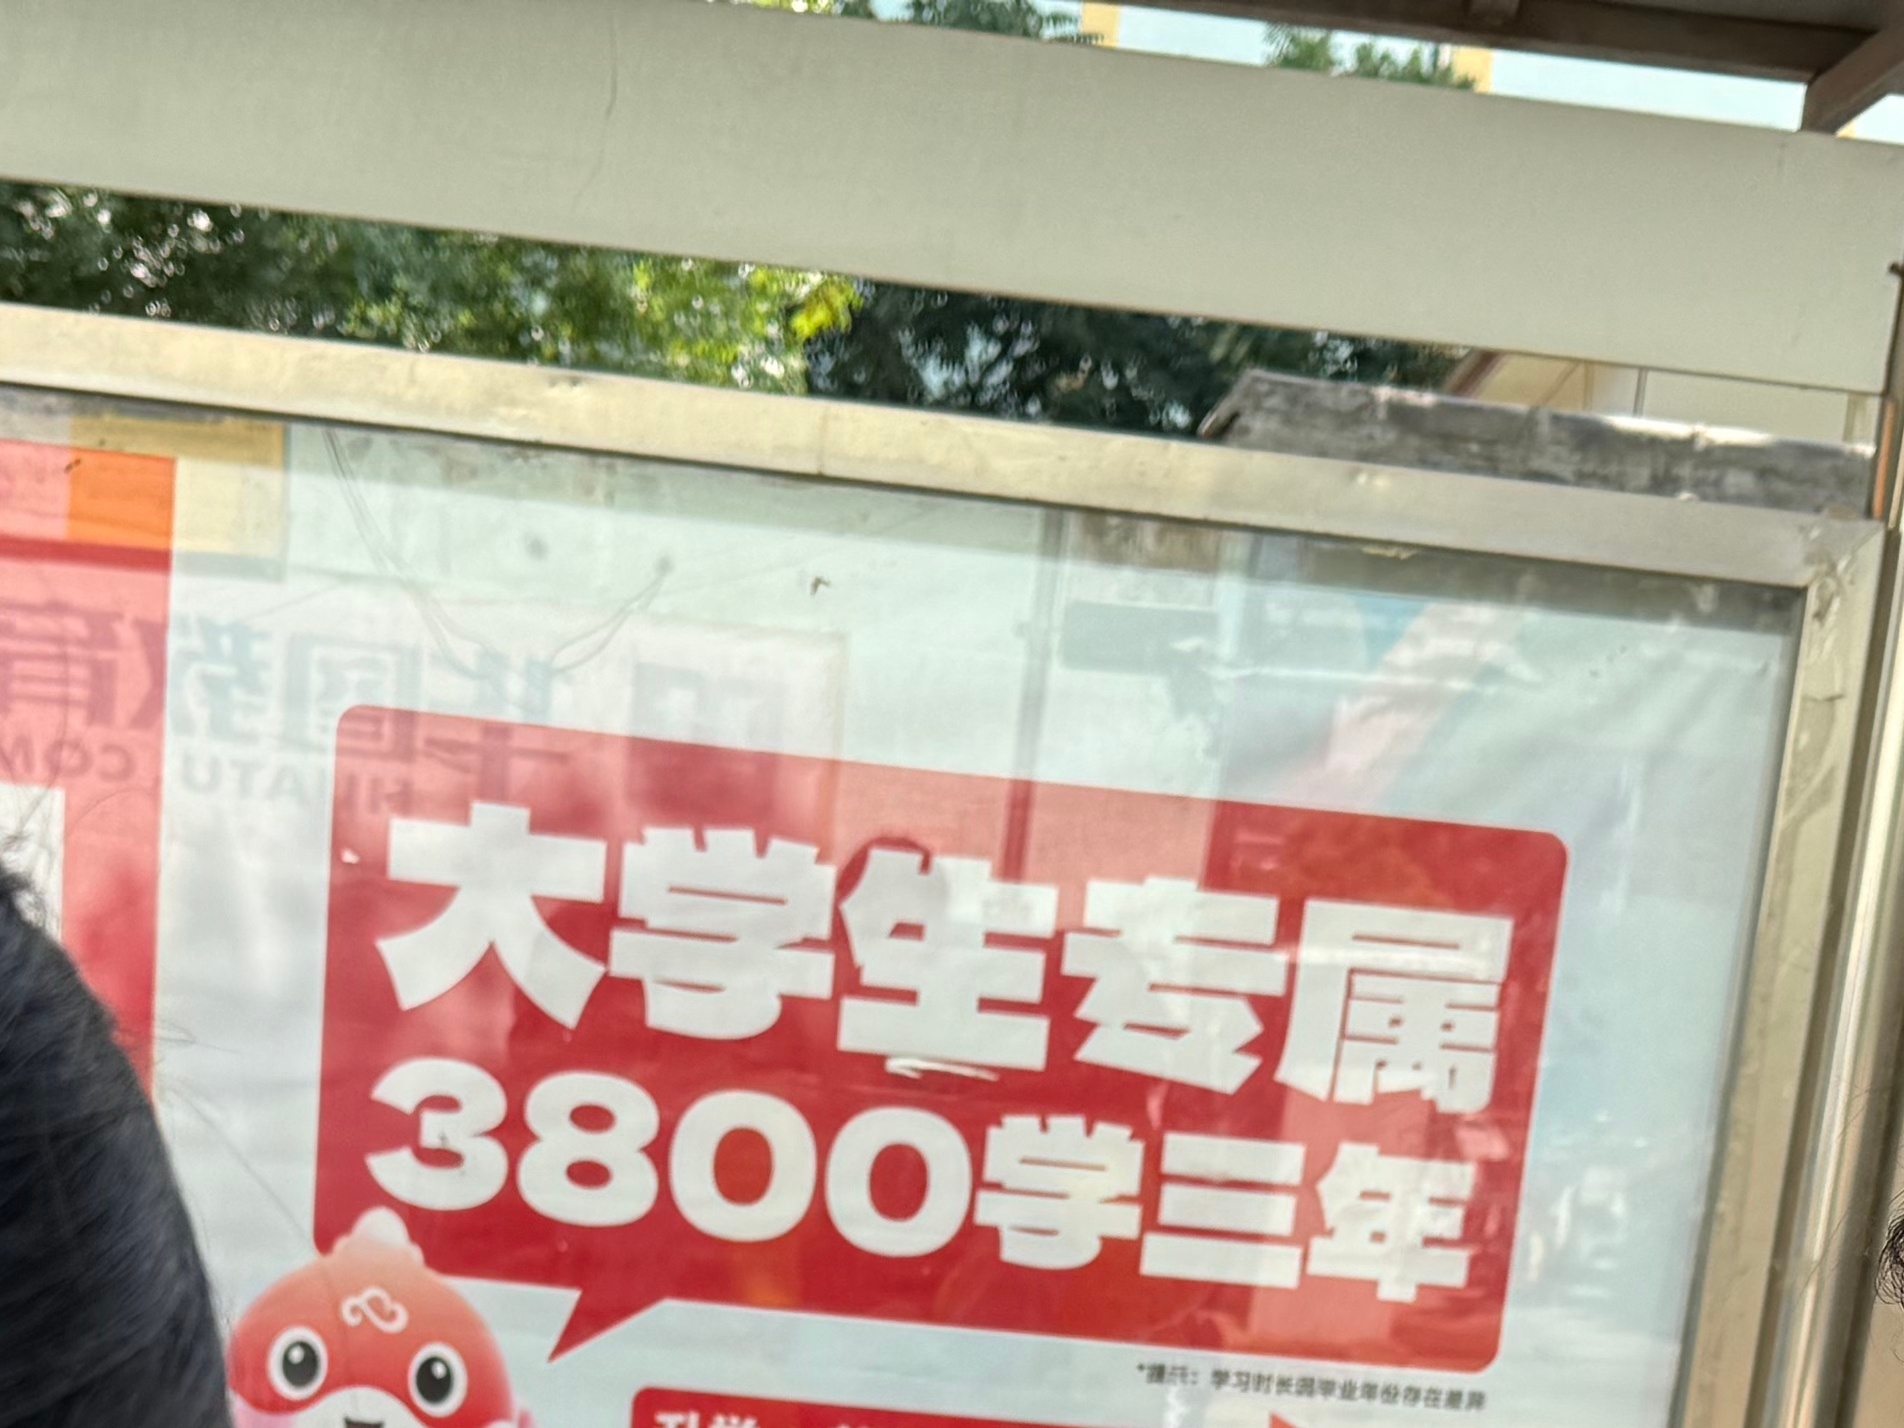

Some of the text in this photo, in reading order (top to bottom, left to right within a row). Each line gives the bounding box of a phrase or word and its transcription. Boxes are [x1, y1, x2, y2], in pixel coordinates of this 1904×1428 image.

[375, 801, 1515, 1113] 大学生专属
[363, 1057, 1480, 1305] 3800学三年
